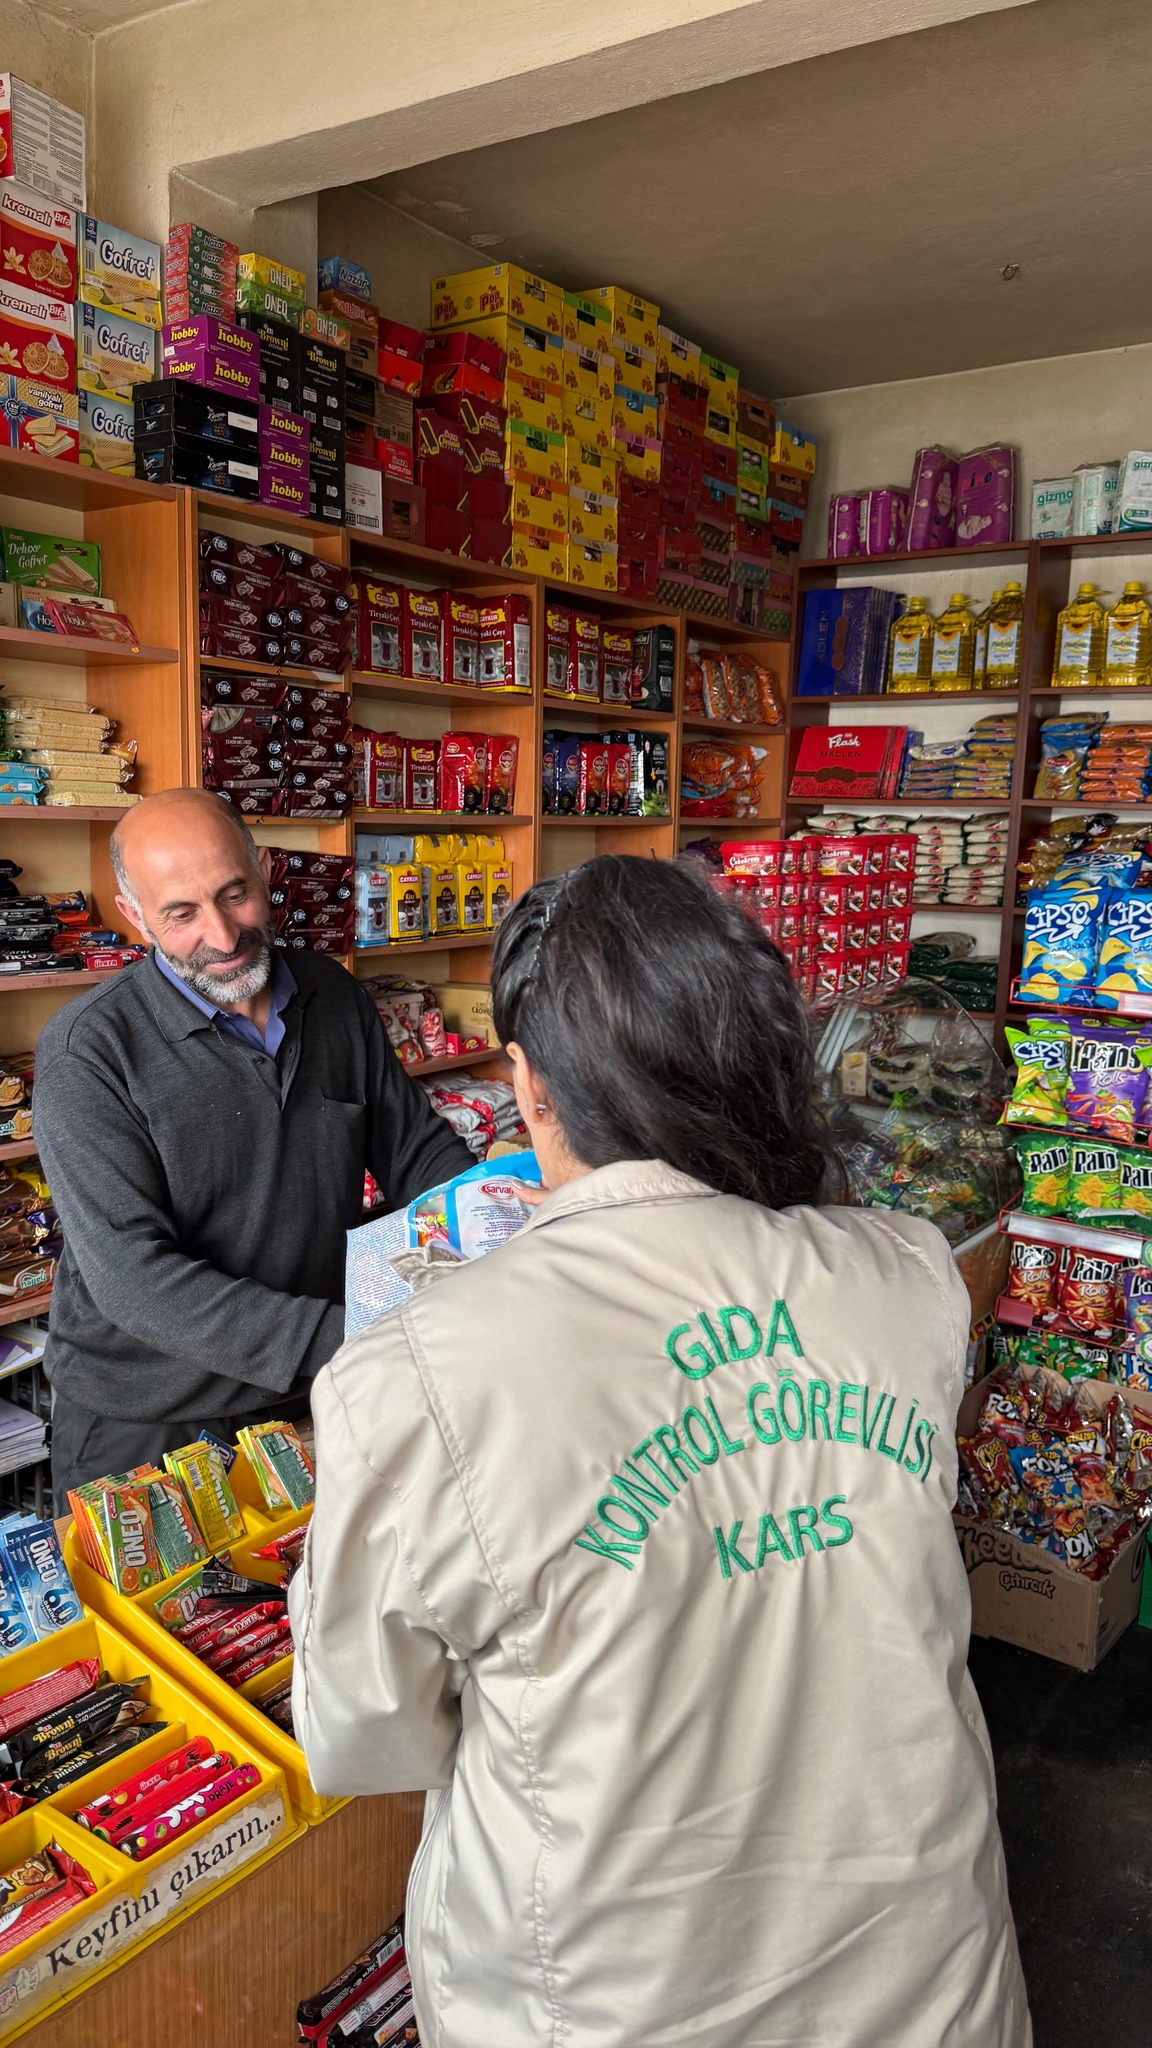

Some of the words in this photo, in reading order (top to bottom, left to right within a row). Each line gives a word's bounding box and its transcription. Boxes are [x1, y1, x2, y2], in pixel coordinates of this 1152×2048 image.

[2, 194, 53, 227] kremalı
[54, 211, 71, 226] Bifa
[204, 236, 226, 250] Nazar
[100, 239, 155, 281] Gofret
[340, 267, 369, 289] Nazar
[48, 304, 66, 318] Bifa
[171, 327, 199, 342] hobby
[316, 317, 338, 338] ONEO
[98, 324, 149, 364] Gofret
[218, 329, 253, 352] hobby
[169, 362, 196, 375] hobby
[215, 364, 252, 387] hobby
[28, 387, 62, 404] vanilyalı
[38, 399, 63, 412] gofret
[270, 415, 304, 436] hobby
[270, 448, 304, 468] hobby
[270, 483, 304, 502] hobby
[1037, 490, 1073, 507] gizmo
[8, 541, 41, 556] Deluxe
[18, 554, 48, 569] Gofret
[817, 610, 830, 672] ADLEN
[828, 734, 861, 749] Flash
[729, 855, 760, 868] Çokokrem
[1089, 1072, 1125, 1088] Rolls
[20, 1270, 48, 1288] halley
[1020, 1270, 1050, 1284] Rolls
[1077, 1284, 1108, 1297] Rolls
[665, 1299, 804, 1380] GIDA
[574, 1396, 745, 1571] KONTROL
[746, 1369, 940, 1484] GÖREVLİSİ
[119, 1510, 147, 1567] ONEO
[713, 1495, 854, 1579] KARS
[29, 1538, 59, 1583] ONEO
[33, 1715, 75, 1744] Browni
[44, 1733, 83, 1761] Browni
[207, 1780, 235, 1803] DRAJE
